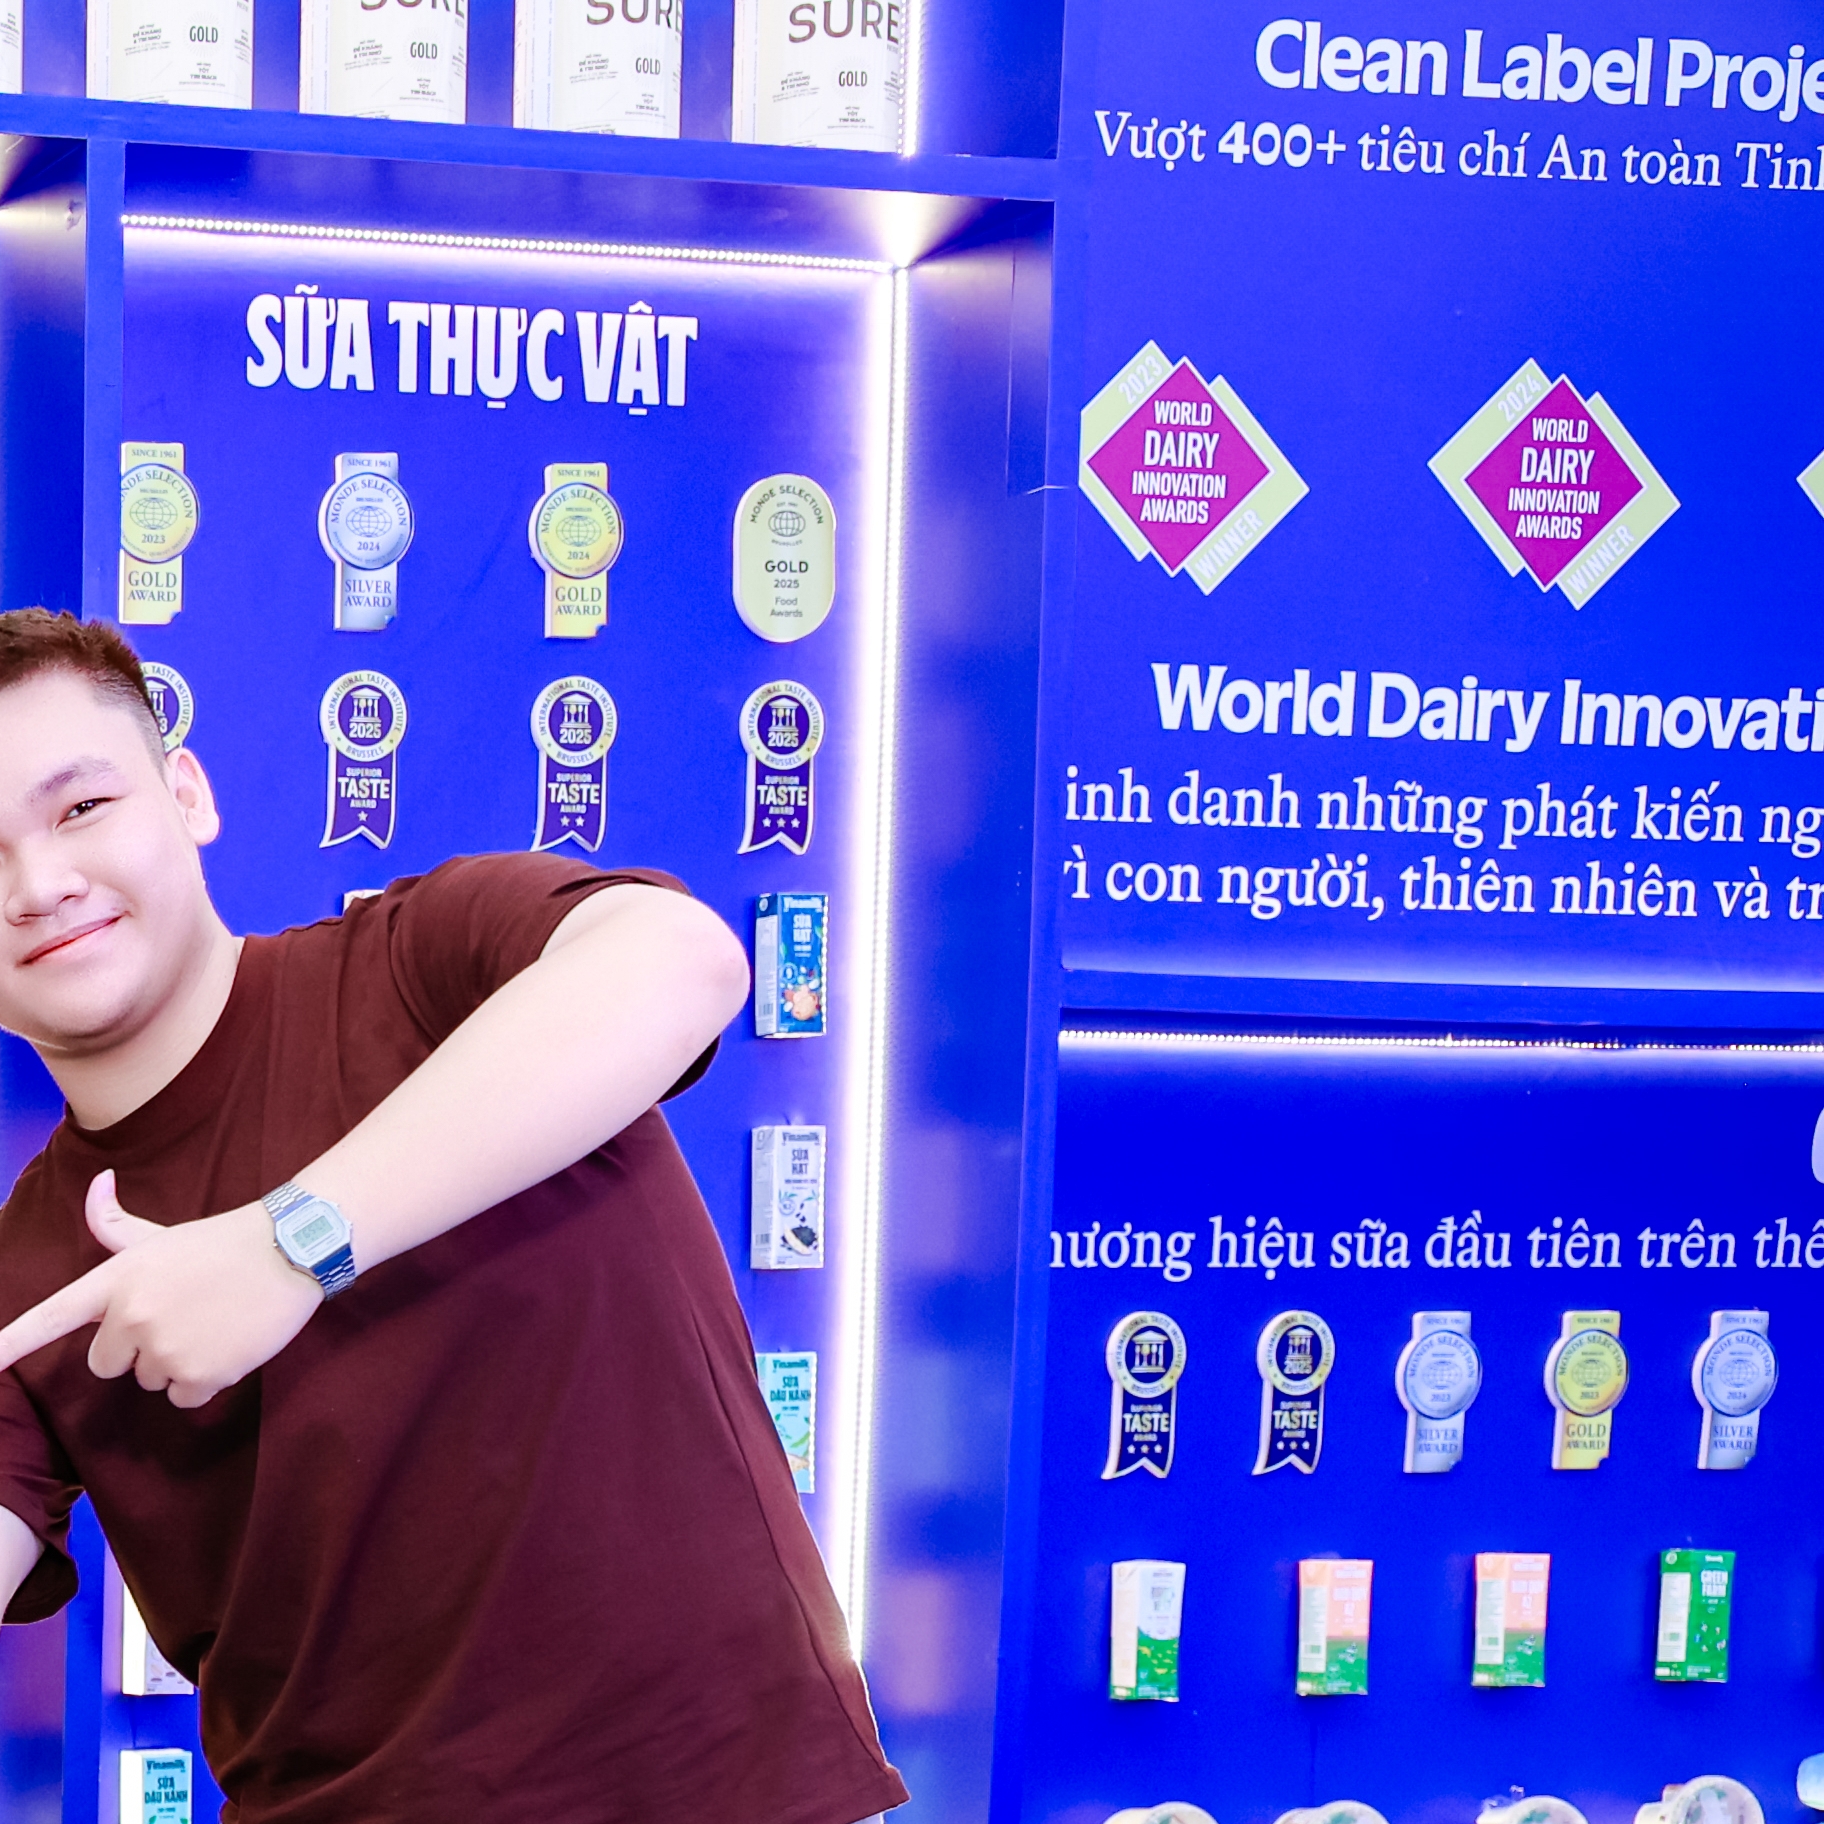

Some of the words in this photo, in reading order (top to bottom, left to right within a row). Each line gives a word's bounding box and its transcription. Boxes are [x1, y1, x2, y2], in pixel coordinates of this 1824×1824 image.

[788, 0, 900, 44] SURE
[189, 25, 219, 44] GOLD
[410, 42, 438, 59] GOLD
[635, 57, 661, 76] GOLD
[1257, 20, 1447, 95] Clean
[1463, 30, 1653, 104] Label
[838, 71, 868, 87] GOLD
[1095, 111, 1206, 171] Vượt
[1219, 122, 1346, 167] 400+
[1358, 124, 1445, 173] tiêu
[1459, 130, 1530, 177] chí
[1537, 135, 1607, 181] An
[1622, 139, 1721, 186] toàn
[247, 284, 374, 390] SỮA
[389, 301, 564, 408] THỰC
[576, 300, 698, 414] VẬT
[1118, 354, 1164, 405] 2023
[1497, 373, 1544, 424] 2024
[1153, 400, 1213, 427] WORLD
[1531, 417, 1589, 443] WORLD
[1143, 429, 1220, 469] DAIRY
[1520, 446, 1595, 485] DAIRY
[1131, 470, 1227, 499] INNOVATION
[331, 481, 359, 523] MONDE
[361, 479, 407, 526] SELECTION
[541, 491, 569, 534] MONDE
[570, 489, 616, 535] SELECTION
[750, 488, 776, 524] MONDE
[779, 485, 824, 525] SELECTION
[1140, 498, 1209, 524] AWARDS
[1507, 487, 1600, 515] INNOVATION
[1515, 515, 1582, 541] AWARDS
[357, 541, 380, 551] 2024
[567, 551, 590, 560] 2024
[1194, 508, 1265, 581] WINNER
[764, 560, 809, 573] GOLD
[1565, 523, 1637, 597] WINNER
[128, 571, 177, 588] GOLD
[345, 579, 391, 594] SILVER
[773, 579, 800, 589] 2025
[128, 590, 177, 603] AWARD
[344, 595, 392, 608] AWARD
[555, 586, 602, 602] GOLD
[774, 597, 798, 606] Food
[555, 605, 602, 616] AWARD
[770, 609, 804, 618] Awards
[1152, 663, 1356, 736] World
[1369, 672, 1550, 752] Dairy
[349, 722, 382, 739] 2025
[559, 728, 592, 745] 2025
[767, 732, 799, 748] 2025
[337, 777, 390, 799] TASTE
[548, 783, 600, 804] TASTE
[757, 785, 808, 806] TASTE
[1169, 770, 1301, 828] danh
[1317, 776, 1487, 848] những
[1499, 782, 1618, 849] phát
[1631, 781, 1743, 841] kiến
[1063, 850, 1090, 898] ì
[1106, 862, 1202, 902] con
[1217, 853, 1384, 920] người,
[1400, 856, 1535, 912] thiên
[1550, 861, 1697, 916] nhiên
[1714, 866, 1770, 919] và
[1208, 1216, 1315, 1280] hiệu
[1331, 1219, 1410, 1268] sữa
[1425, 1210, 1511, 1268] đầu
[1528, 1217, 1621, 1268] tiên
[1638, 1219, 1736, 1268] trên
[1123, 1413, 1170, 1433] TASTE
[1273, 1410, 1318, 1429] TASTE
